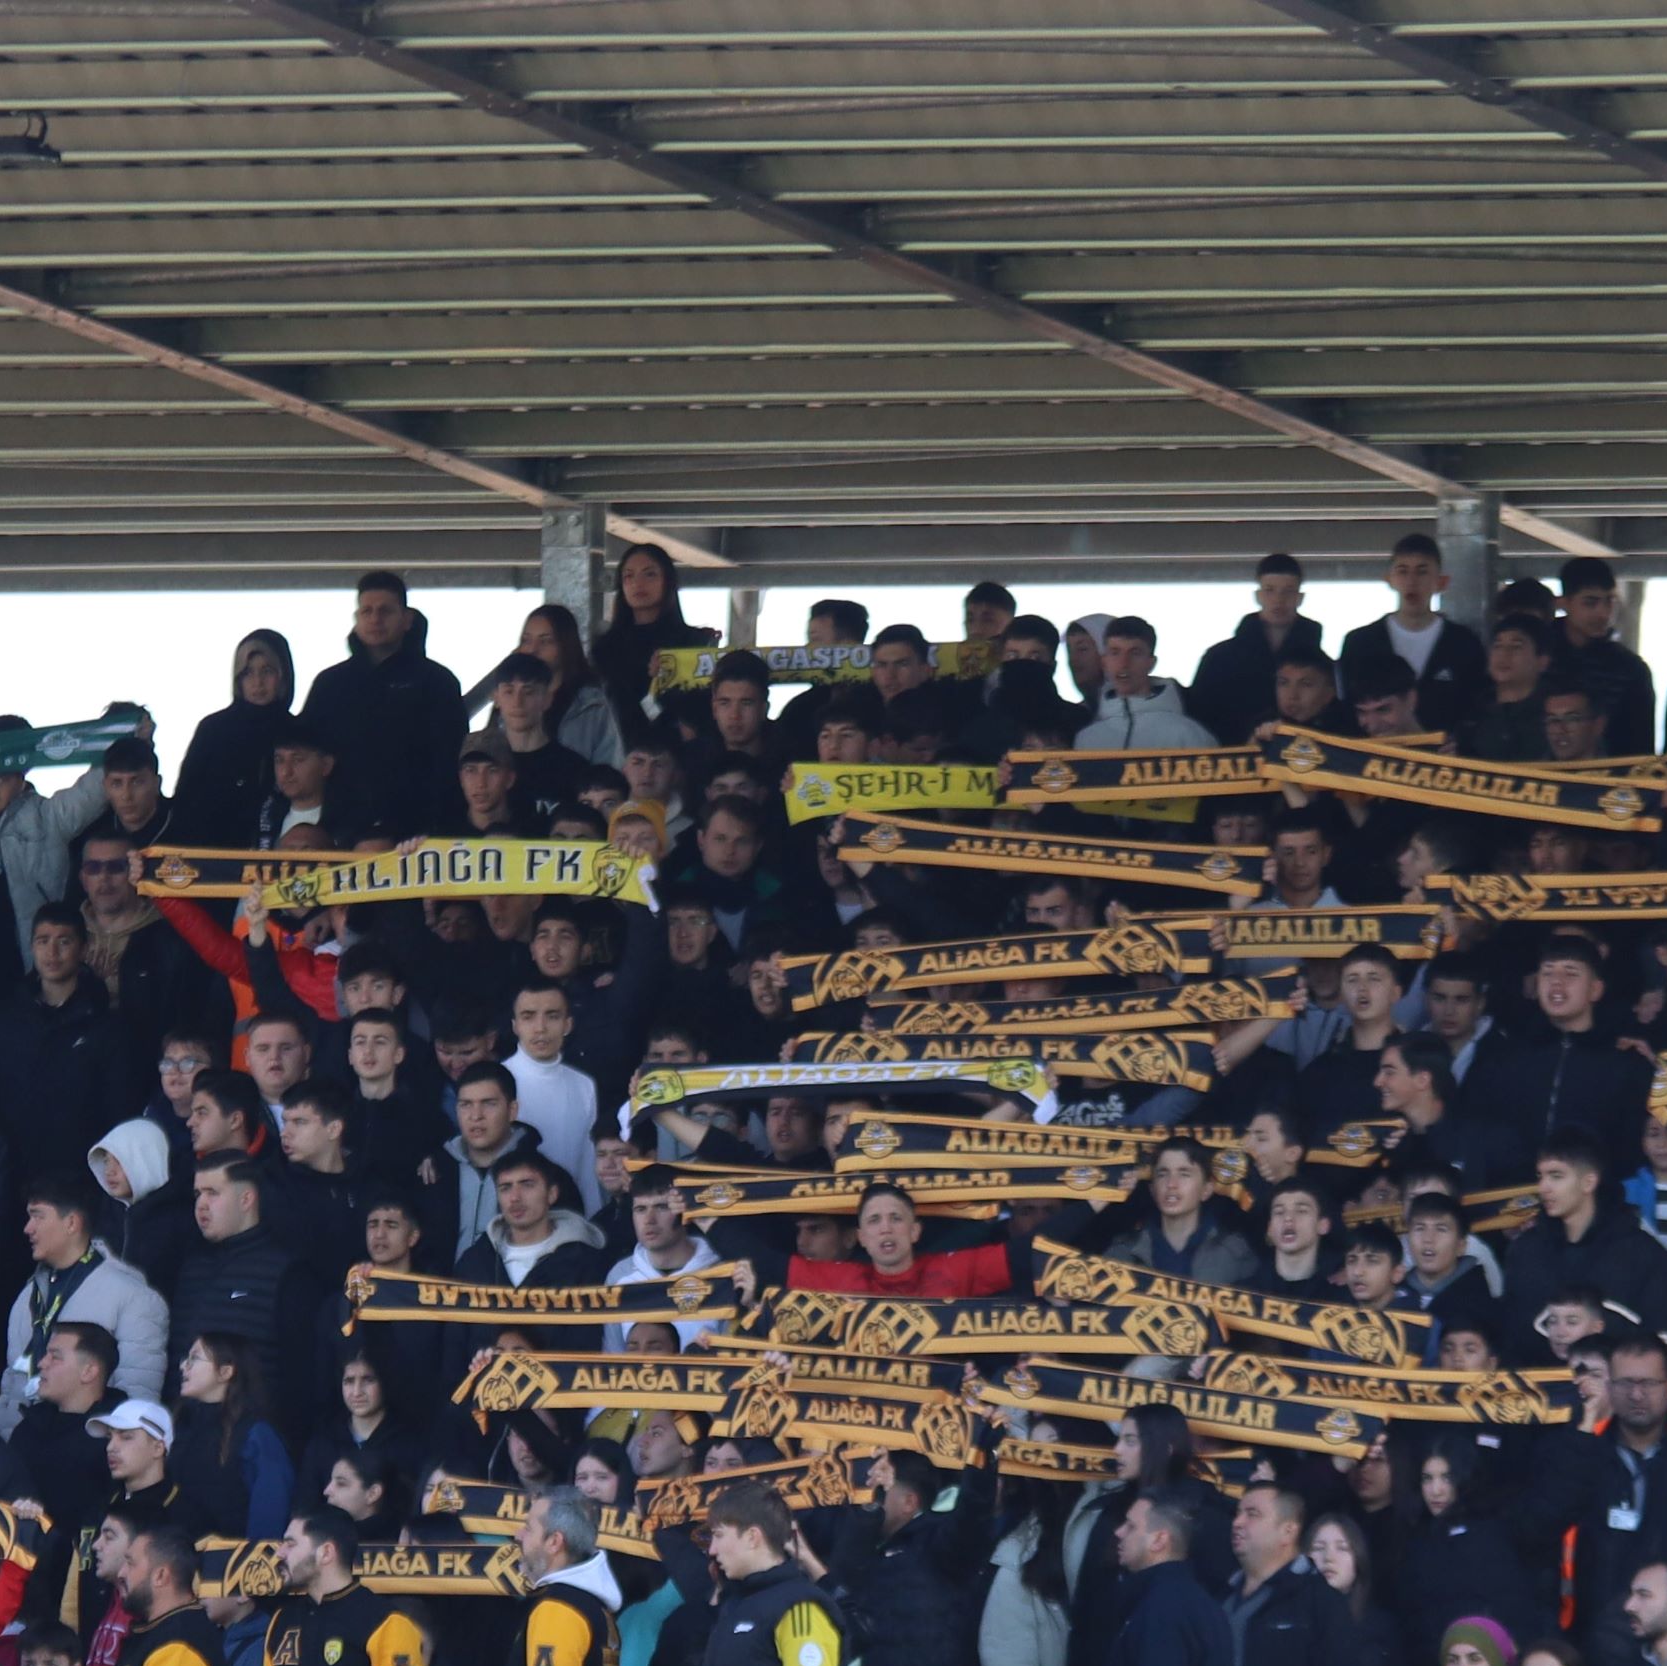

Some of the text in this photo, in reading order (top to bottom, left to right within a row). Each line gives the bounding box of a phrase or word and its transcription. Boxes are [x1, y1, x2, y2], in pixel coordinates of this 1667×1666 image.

[525, 847, 583, 883] FK
[1033, 942, 1070, 963] FK
[1040, 1040, 1080, 1061] FK
[1072, 1311, 1110, 1335] FK
[1261, 1298, 1300, 1325] FK
[686, 1369, 725, 1393] FK
[1408, 1381, 1444, 1405] FK
[881, 1405, 905, 1430] FK
[437, 1551, 472, 1576] FK
[273, 1628, 301, 1666] A
